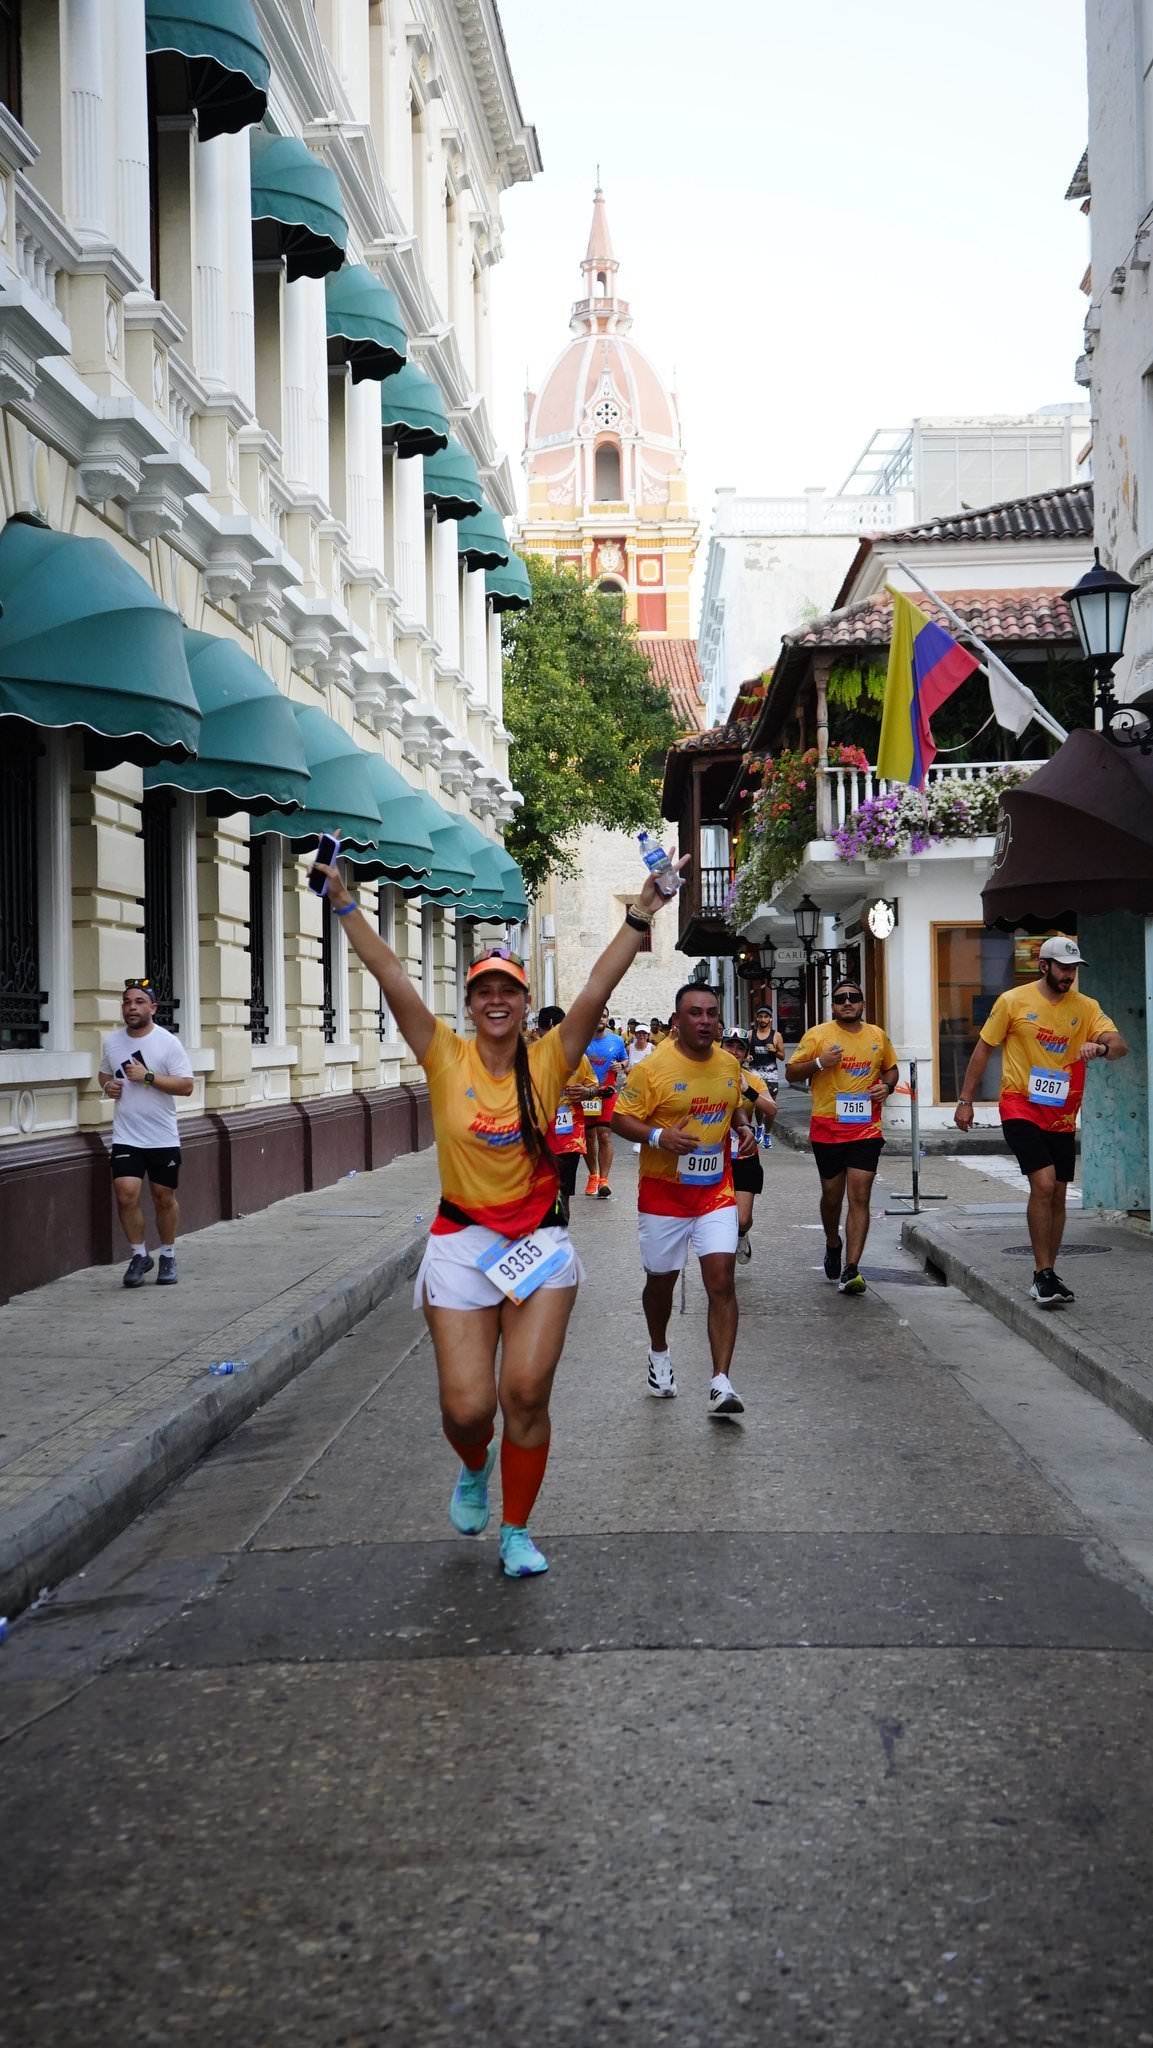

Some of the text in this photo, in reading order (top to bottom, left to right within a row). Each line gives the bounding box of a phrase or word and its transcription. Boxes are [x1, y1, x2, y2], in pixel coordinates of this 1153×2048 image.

[1035, 1079, 1062, 1095] 9267
[844, 1102, 864, 1113] 7515
[688, 1156, 717, 1171] 9100
[499, 1240, 542, 1280] 9355
